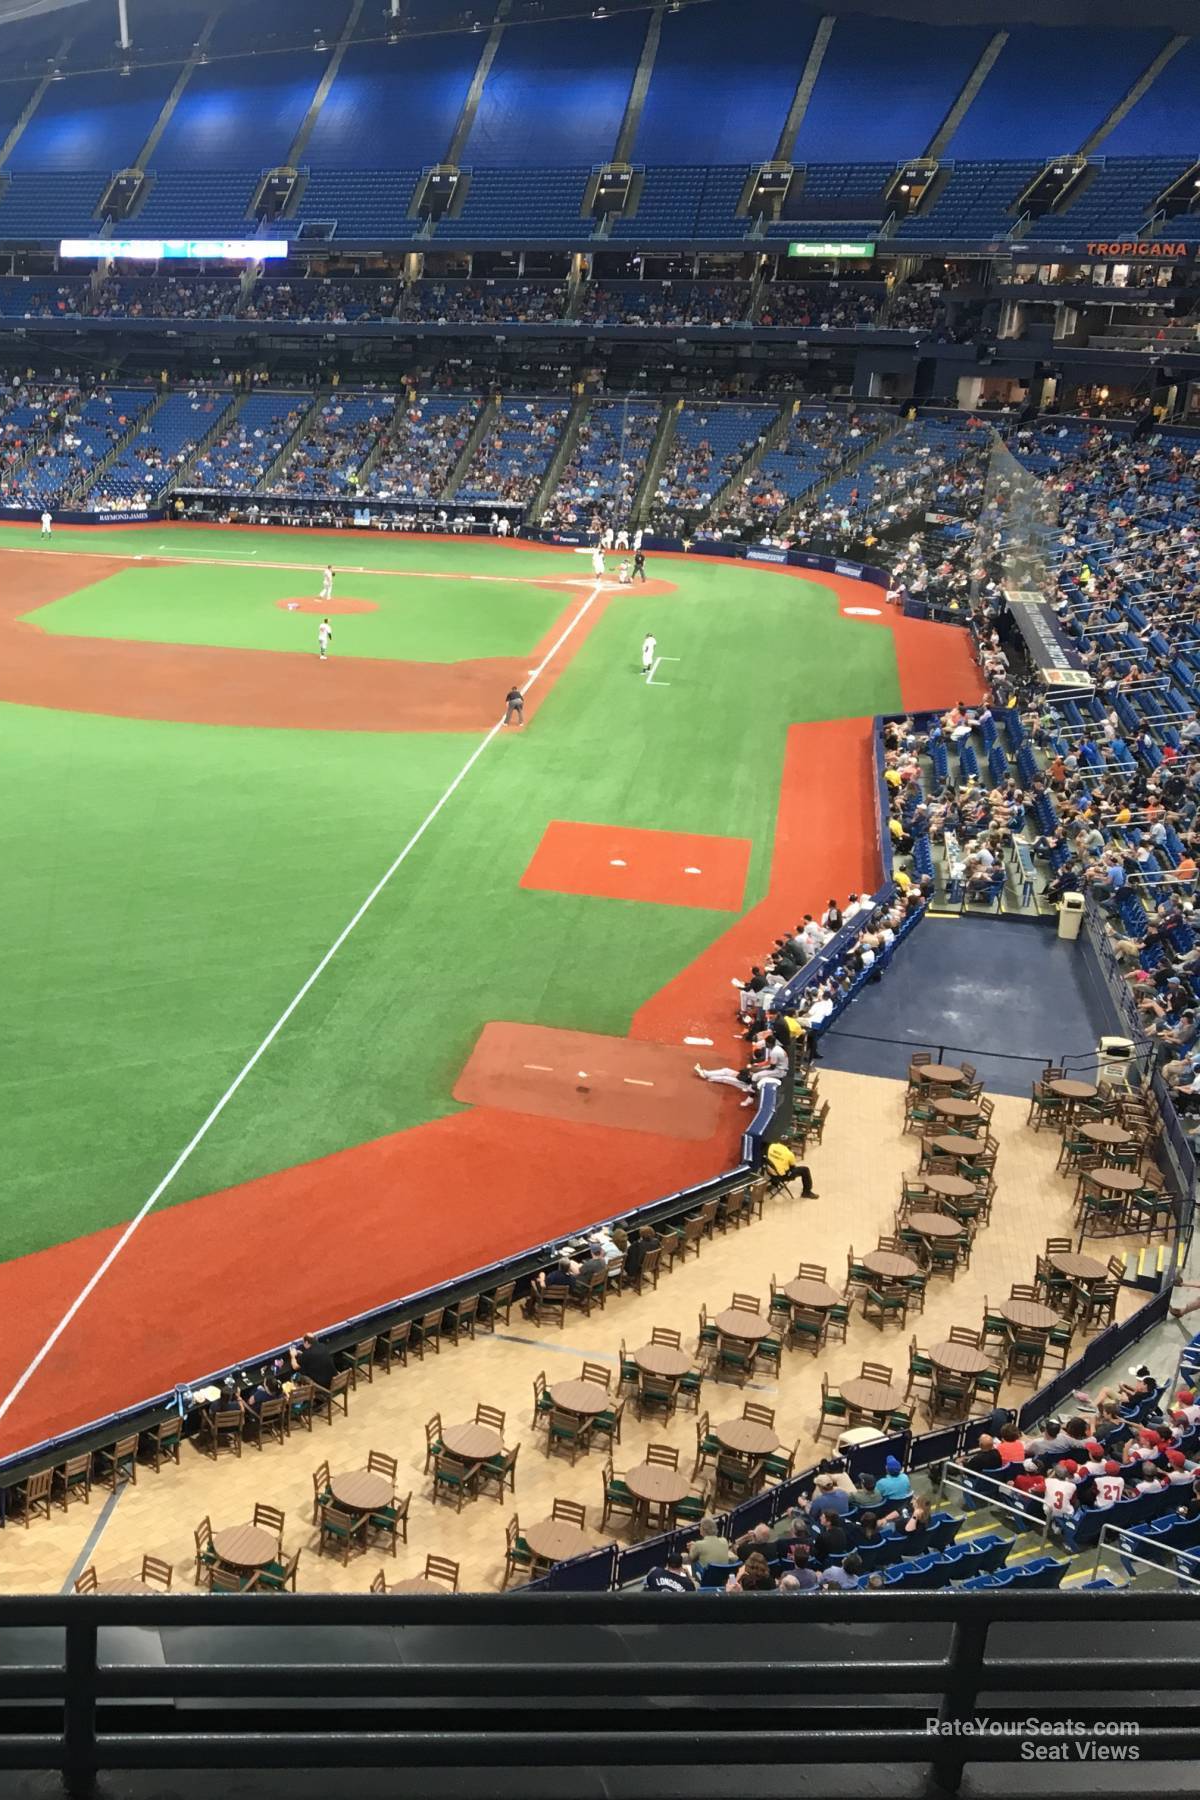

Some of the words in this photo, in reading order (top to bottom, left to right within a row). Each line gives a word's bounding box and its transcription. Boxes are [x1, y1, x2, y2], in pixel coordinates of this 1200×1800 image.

[1086, 243, 1187, 256] TROPICANA
[1053, 1490, 1064, 1510] 3
[1103, 1484, 1121, 1501] 27
